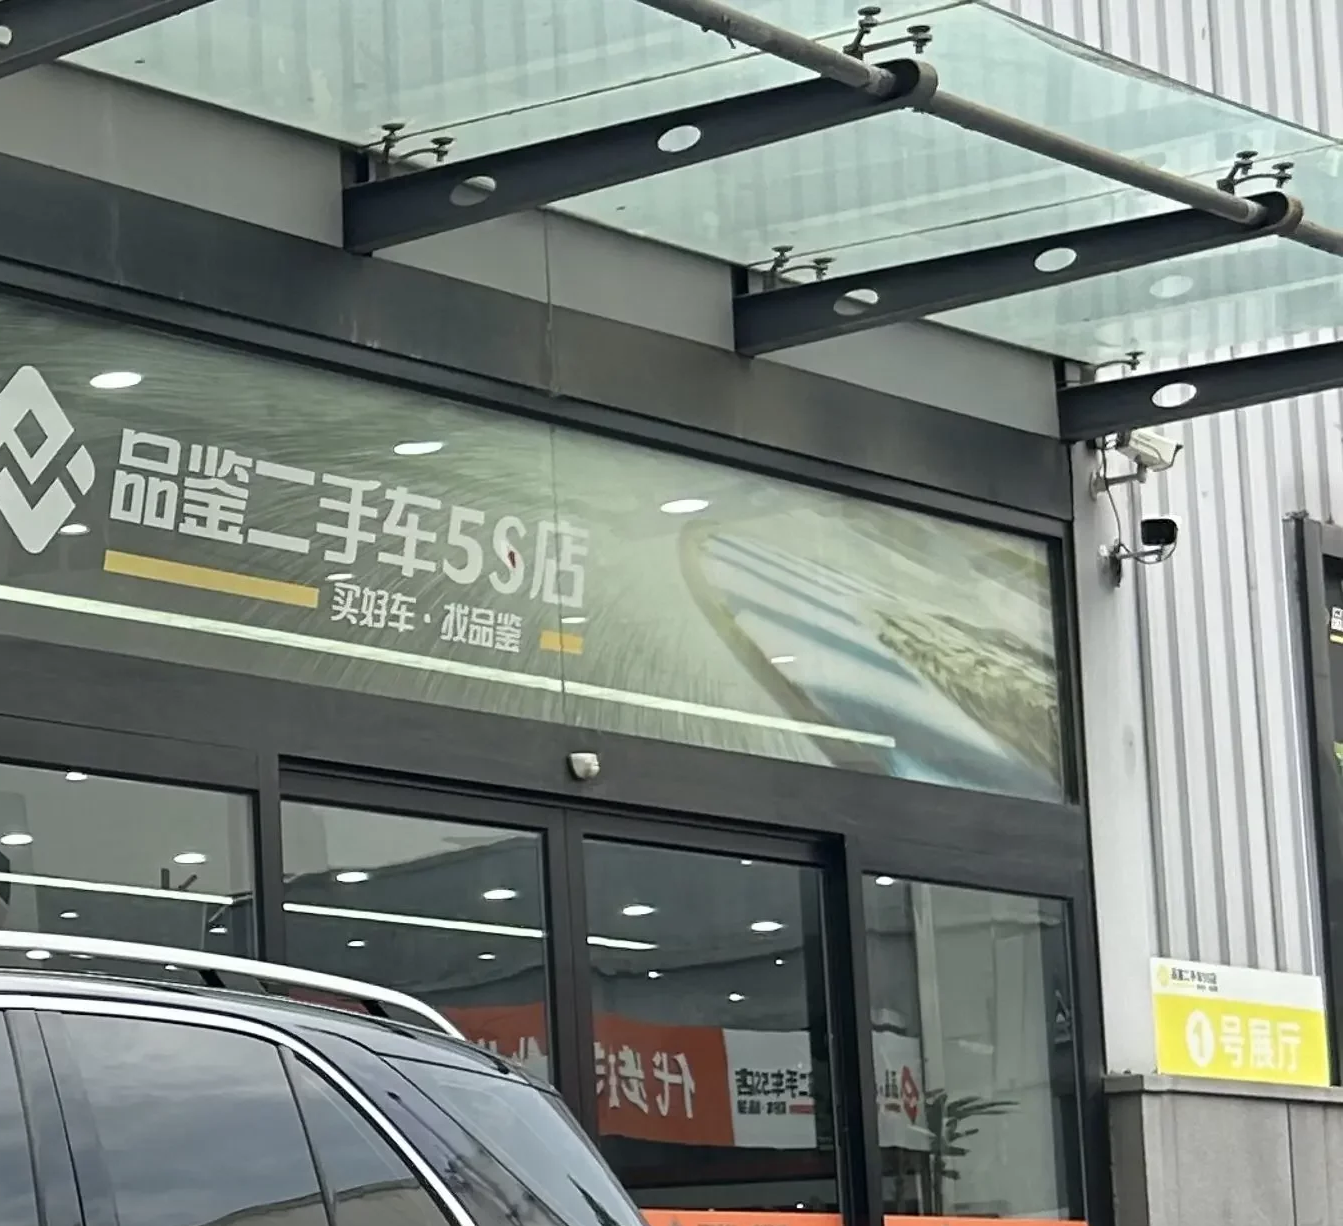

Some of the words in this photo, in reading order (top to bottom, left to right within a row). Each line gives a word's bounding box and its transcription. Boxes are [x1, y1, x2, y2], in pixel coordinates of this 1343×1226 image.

[109, 427, 590, 608] 品鉴二手车5S店
